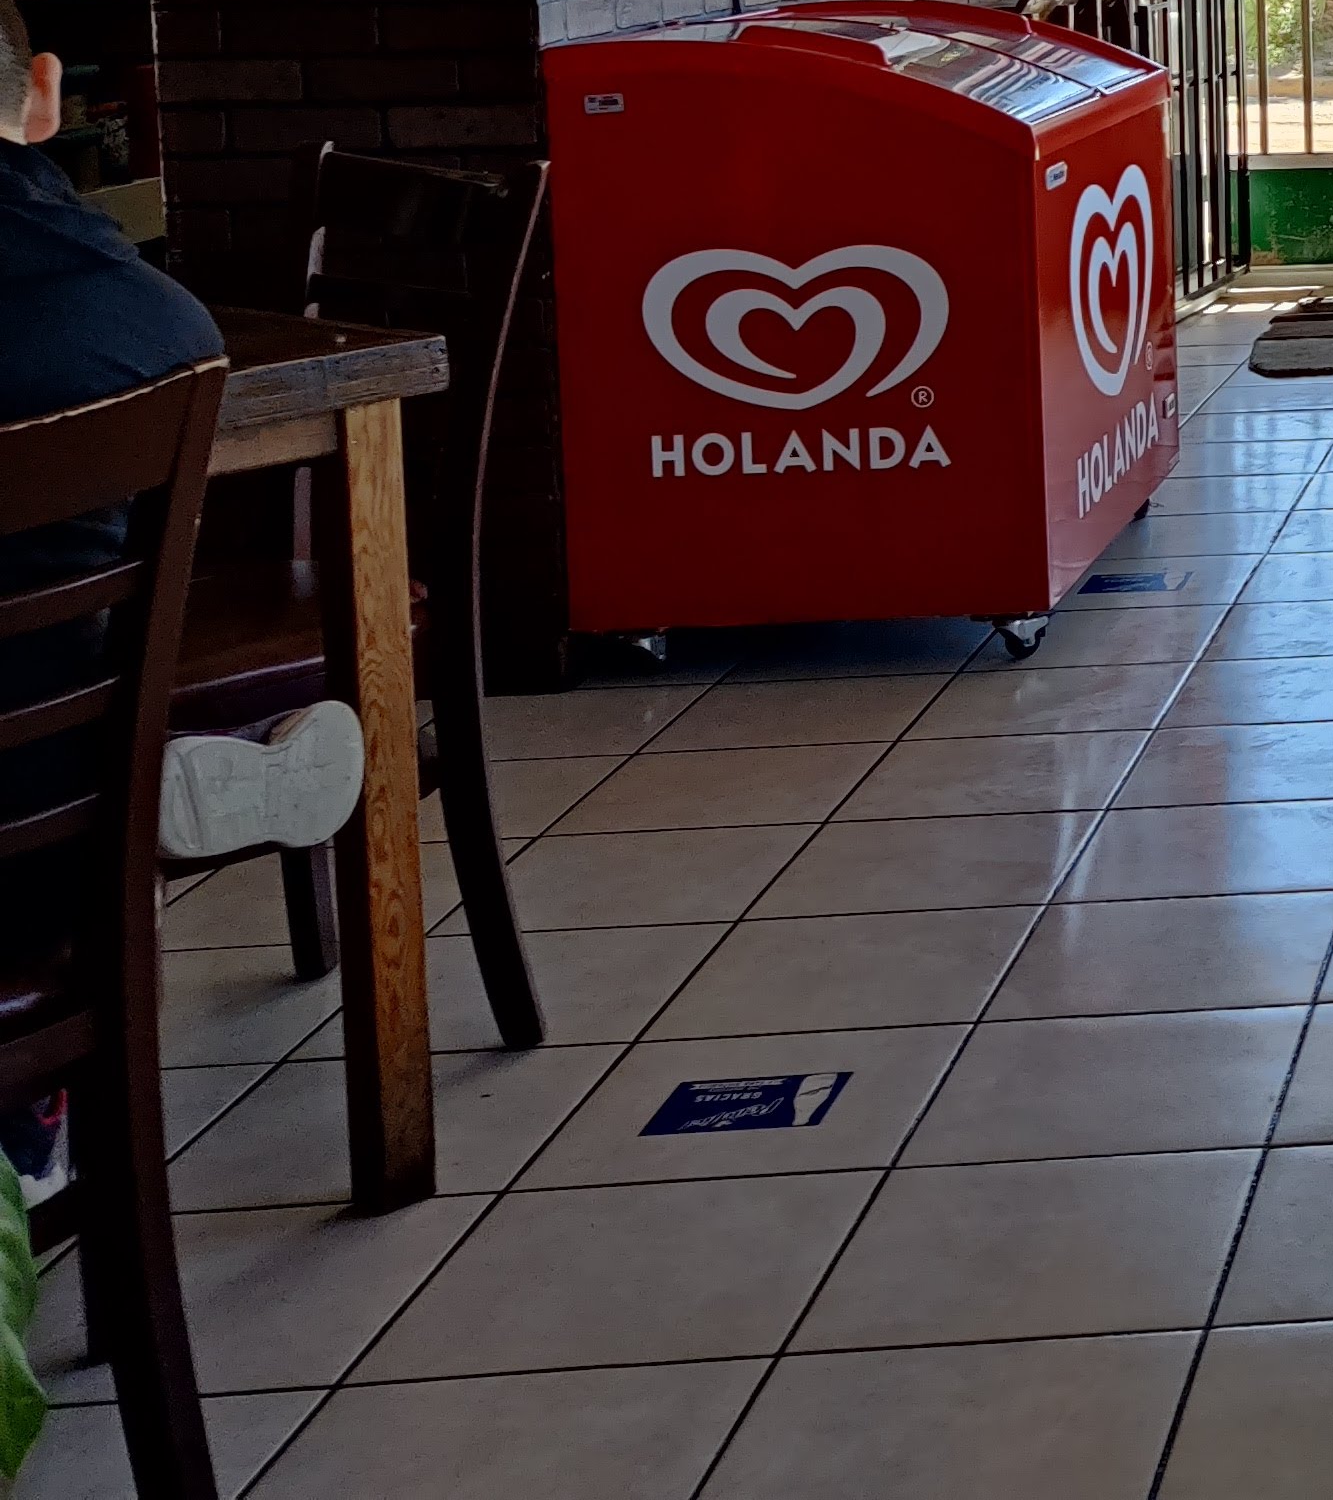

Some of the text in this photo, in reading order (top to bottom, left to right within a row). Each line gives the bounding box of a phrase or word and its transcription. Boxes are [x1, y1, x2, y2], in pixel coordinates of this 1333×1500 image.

[651, 424, 952, 479] HOLANDA
[1077, 391, 1160, 520] HOLANDA
[693, 1091, 763, 1103] GRACIAS
